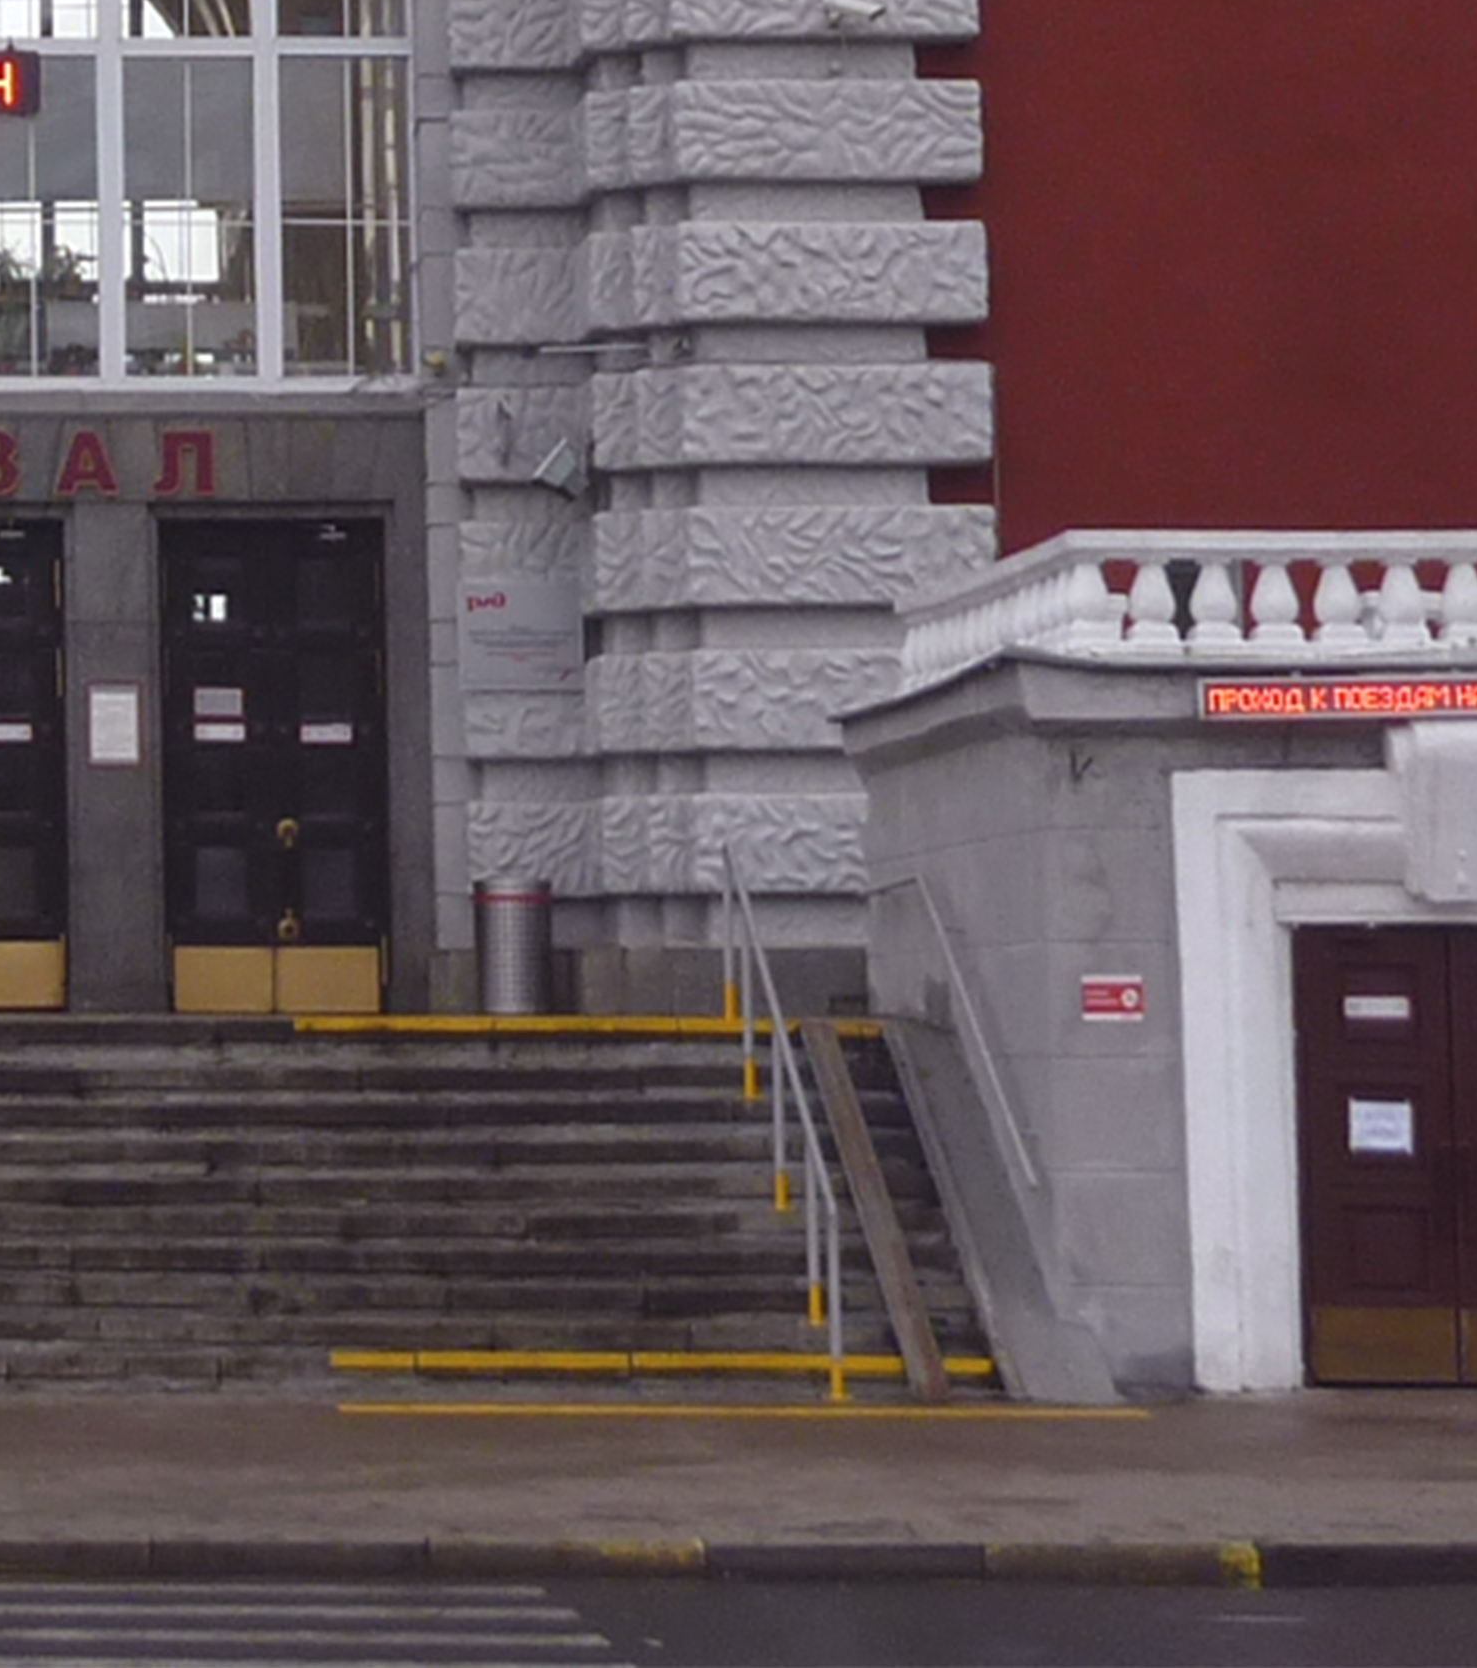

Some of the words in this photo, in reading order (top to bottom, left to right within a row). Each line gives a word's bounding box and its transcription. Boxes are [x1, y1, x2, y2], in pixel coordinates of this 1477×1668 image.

[1208, 688, 1305, 712] ПРОХОД
[1310, 687, 1328, 710] К
[1334, 686, 1451, 711] ПОЕЗДАМ
